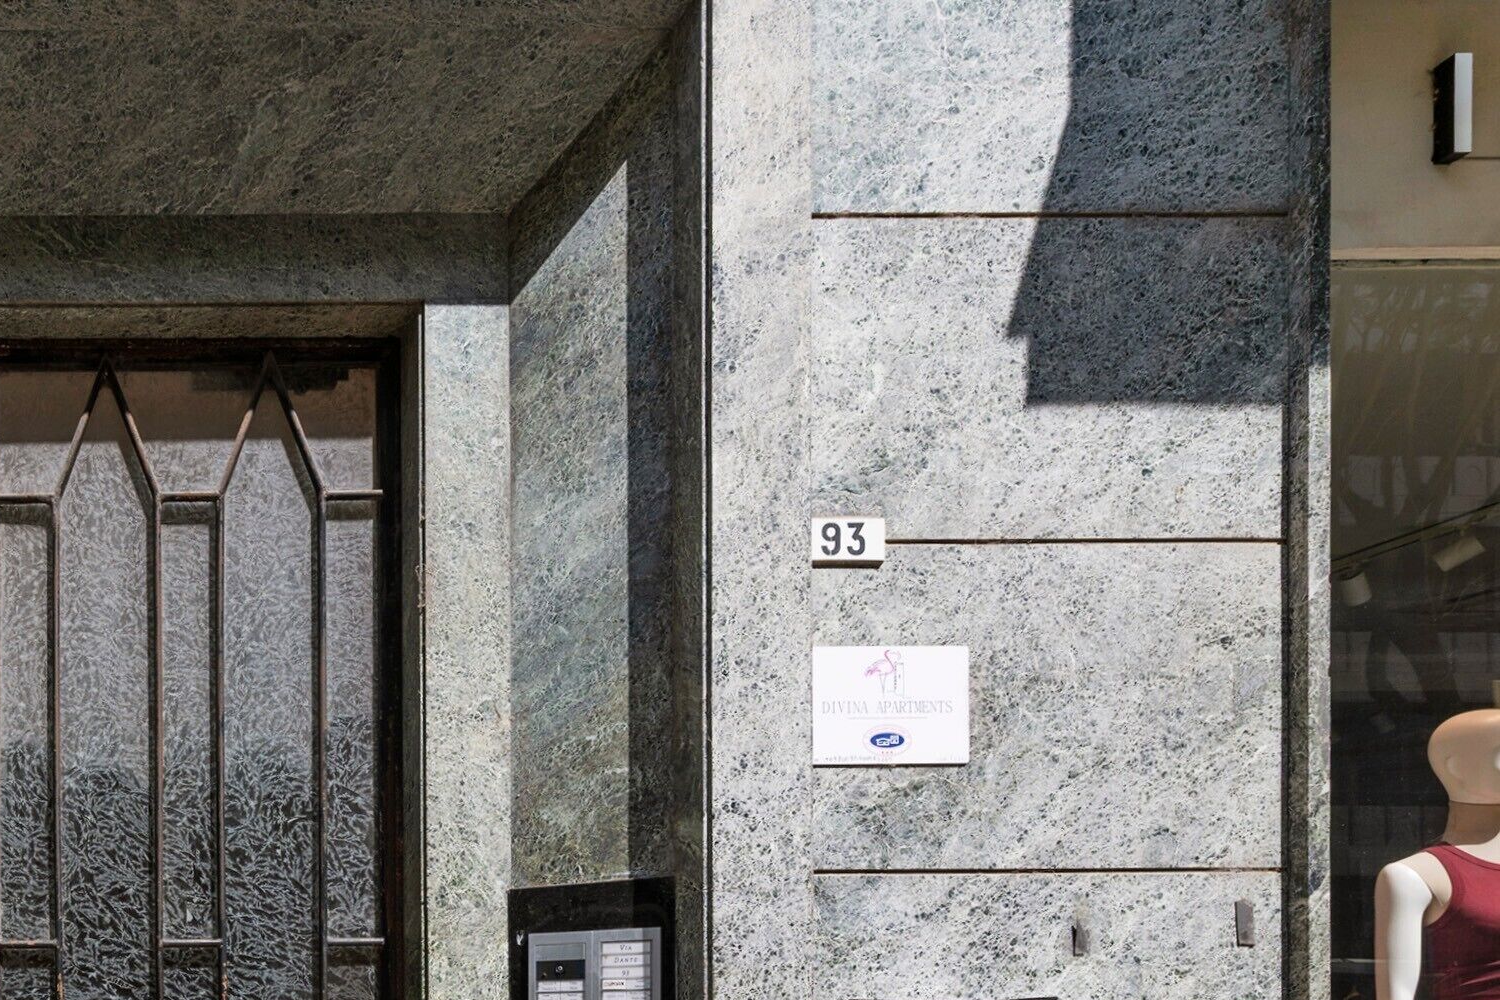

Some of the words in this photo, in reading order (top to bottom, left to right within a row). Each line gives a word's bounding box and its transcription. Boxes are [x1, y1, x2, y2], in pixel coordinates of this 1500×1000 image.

[820, 522, 866, 556] 93
[821, 700, 869, 714] DIVINA
[877, 700, 954, 714] APARTMENTS
